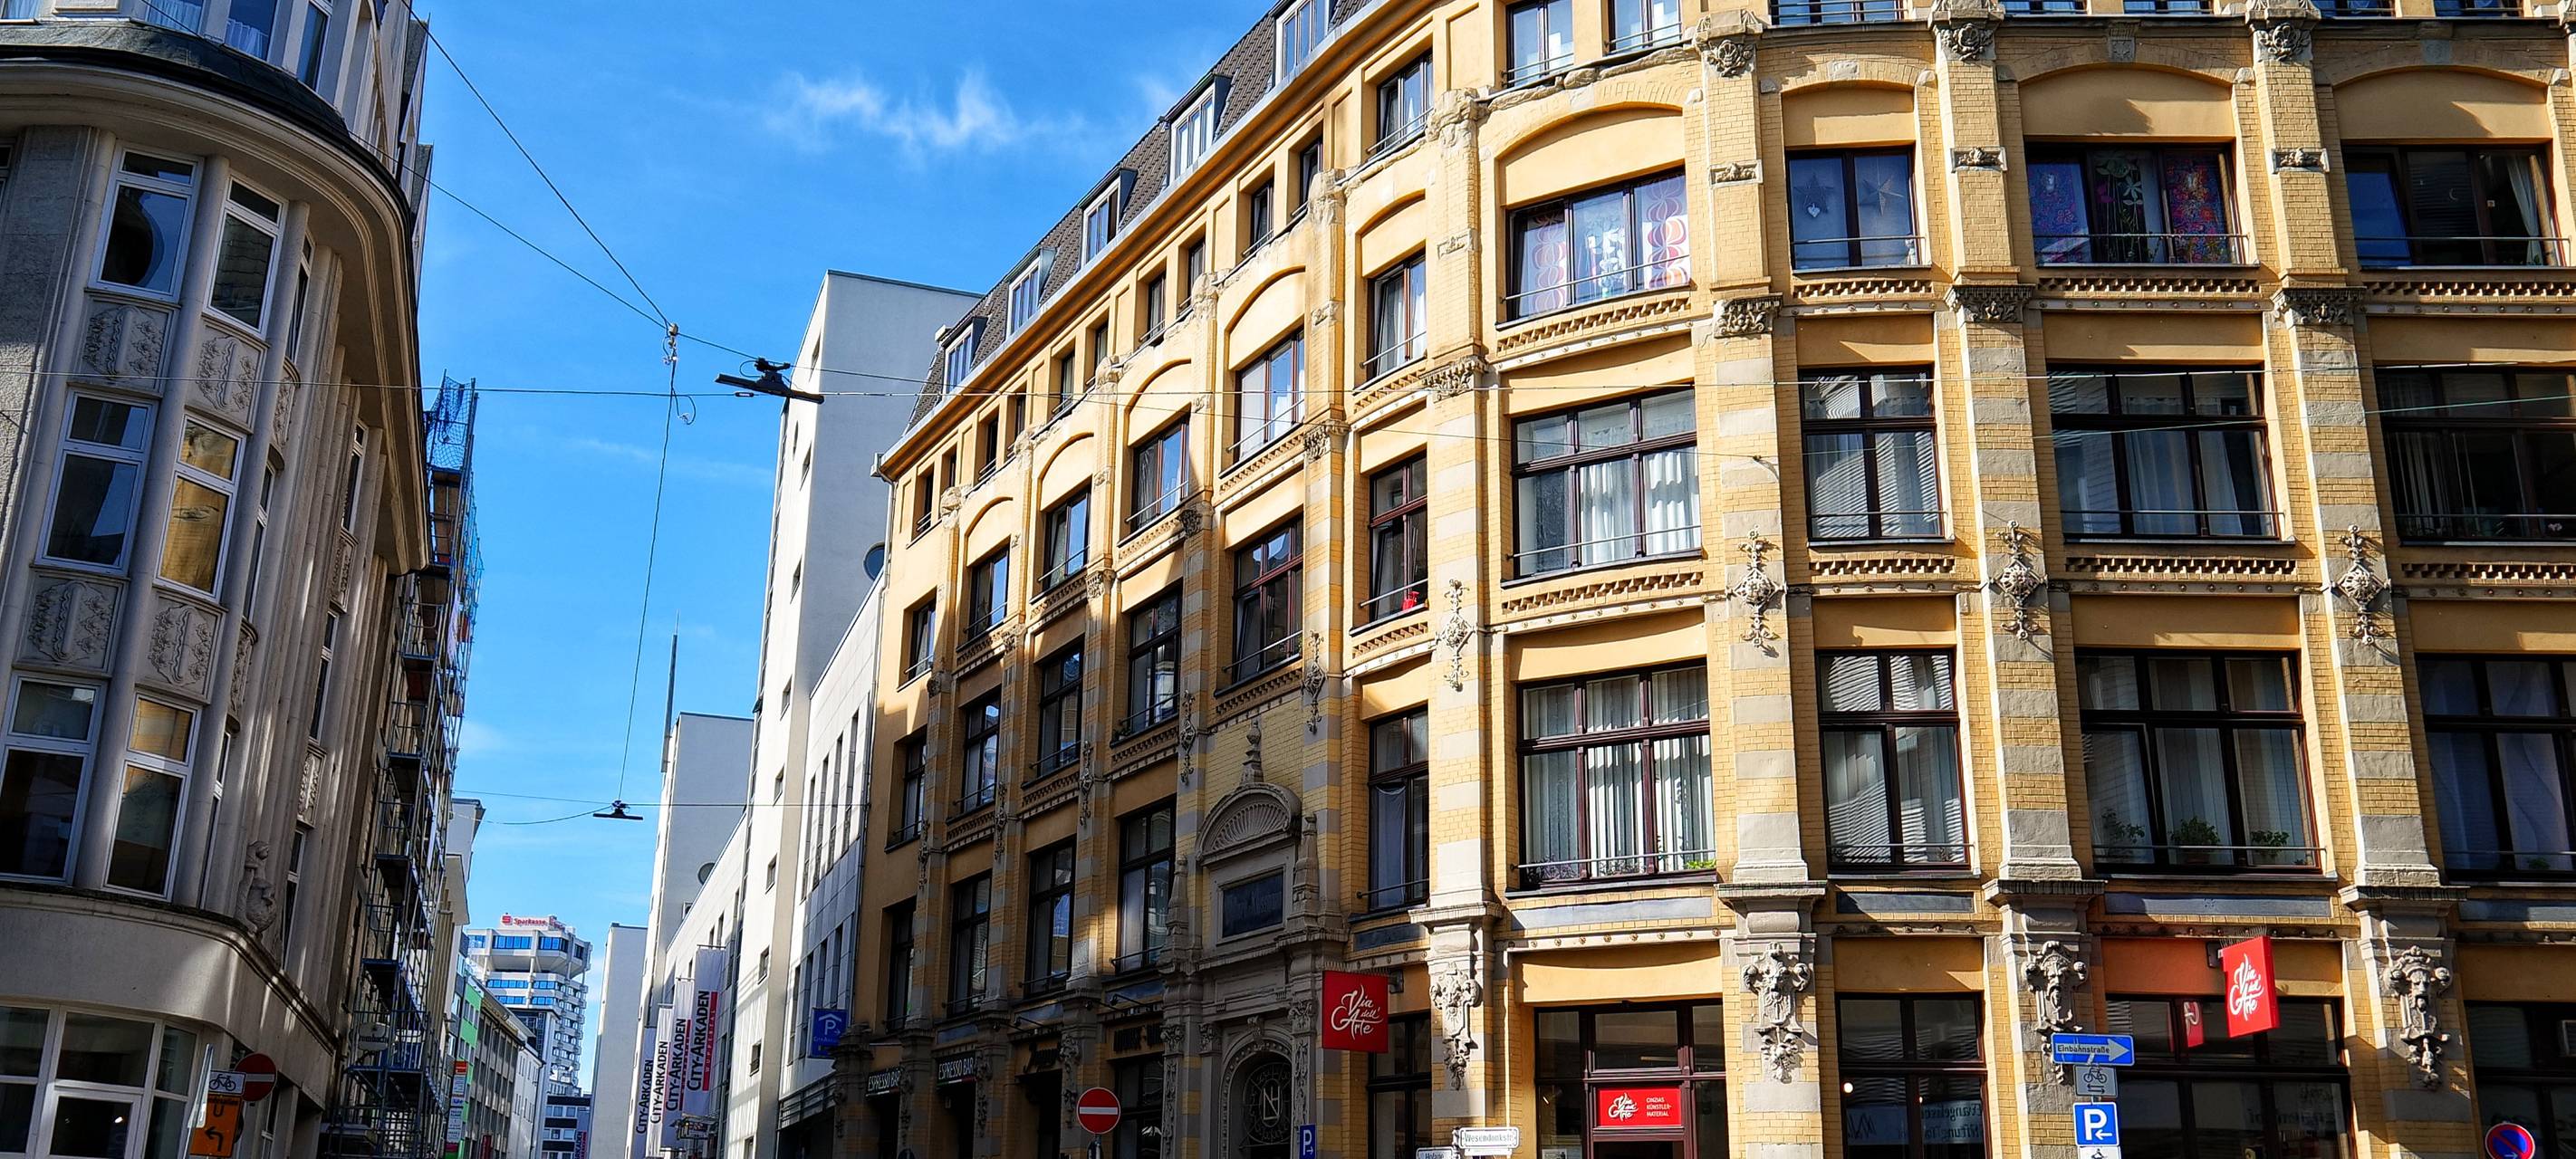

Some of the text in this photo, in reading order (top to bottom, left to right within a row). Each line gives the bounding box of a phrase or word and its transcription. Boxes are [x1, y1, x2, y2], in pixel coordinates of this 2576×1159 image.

[513, 917, 547, 926] Sparkasse
[2234, 953, 2257, 994] Via
[1341, 983, 1375, 1017] Via
[1331, 1006, 1384, 1040] Arte
[686, 990, 710, 1091] CITY-ARKADEN
[2057, 1044, 2110, 1054] Einbahnstraße
[666, 1018, 687, 1111] CITY-ARKADEN
[868, 1070, 900, 1092] ESPRESSO BAR
[938, 1057, 975, 1080] ESPRESSO BAR
[635, 1059, 654, 1134] CITY-ARKADEN
[649, 1040, 668, 1124] CITY-ARKADEN
[2083, 1108, 2108, 1141] P
[1302, 1129, 1312, 1156] P
